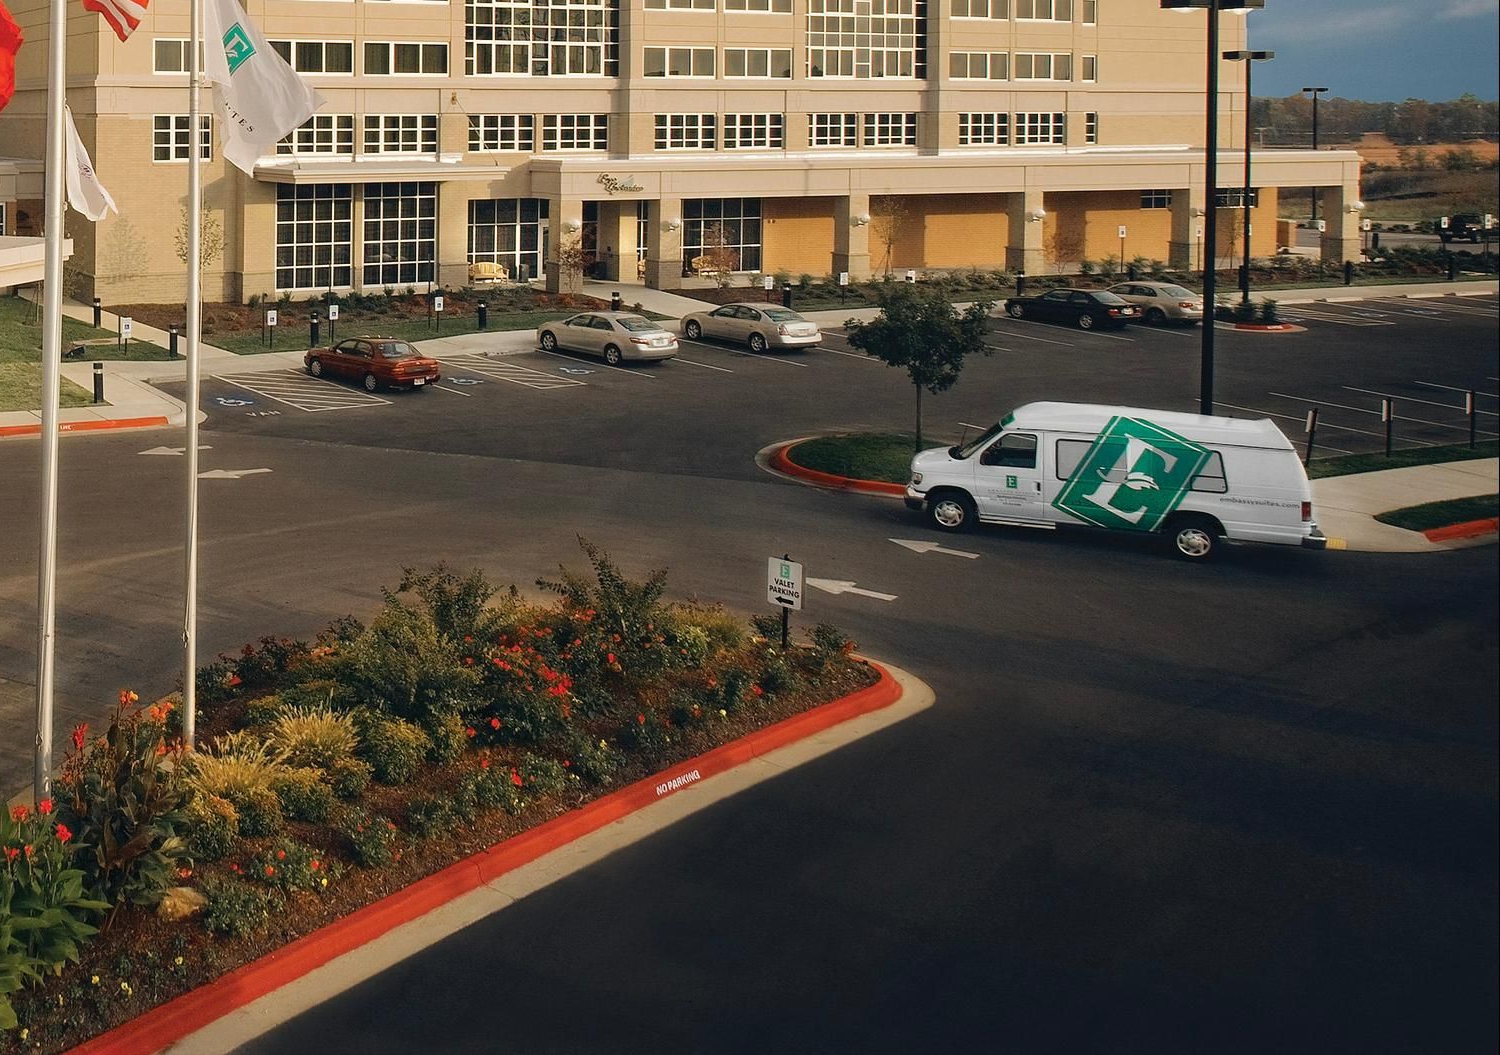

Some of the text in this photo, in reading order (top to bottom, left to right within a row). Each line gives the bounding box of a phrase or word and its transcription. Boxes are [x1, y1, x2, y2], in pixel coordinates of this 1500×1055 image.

[774, 578, 795, 589] VALET
[769, 585, 800, 599] PARKING
[656, 769, 701, 796] NO PARKING
